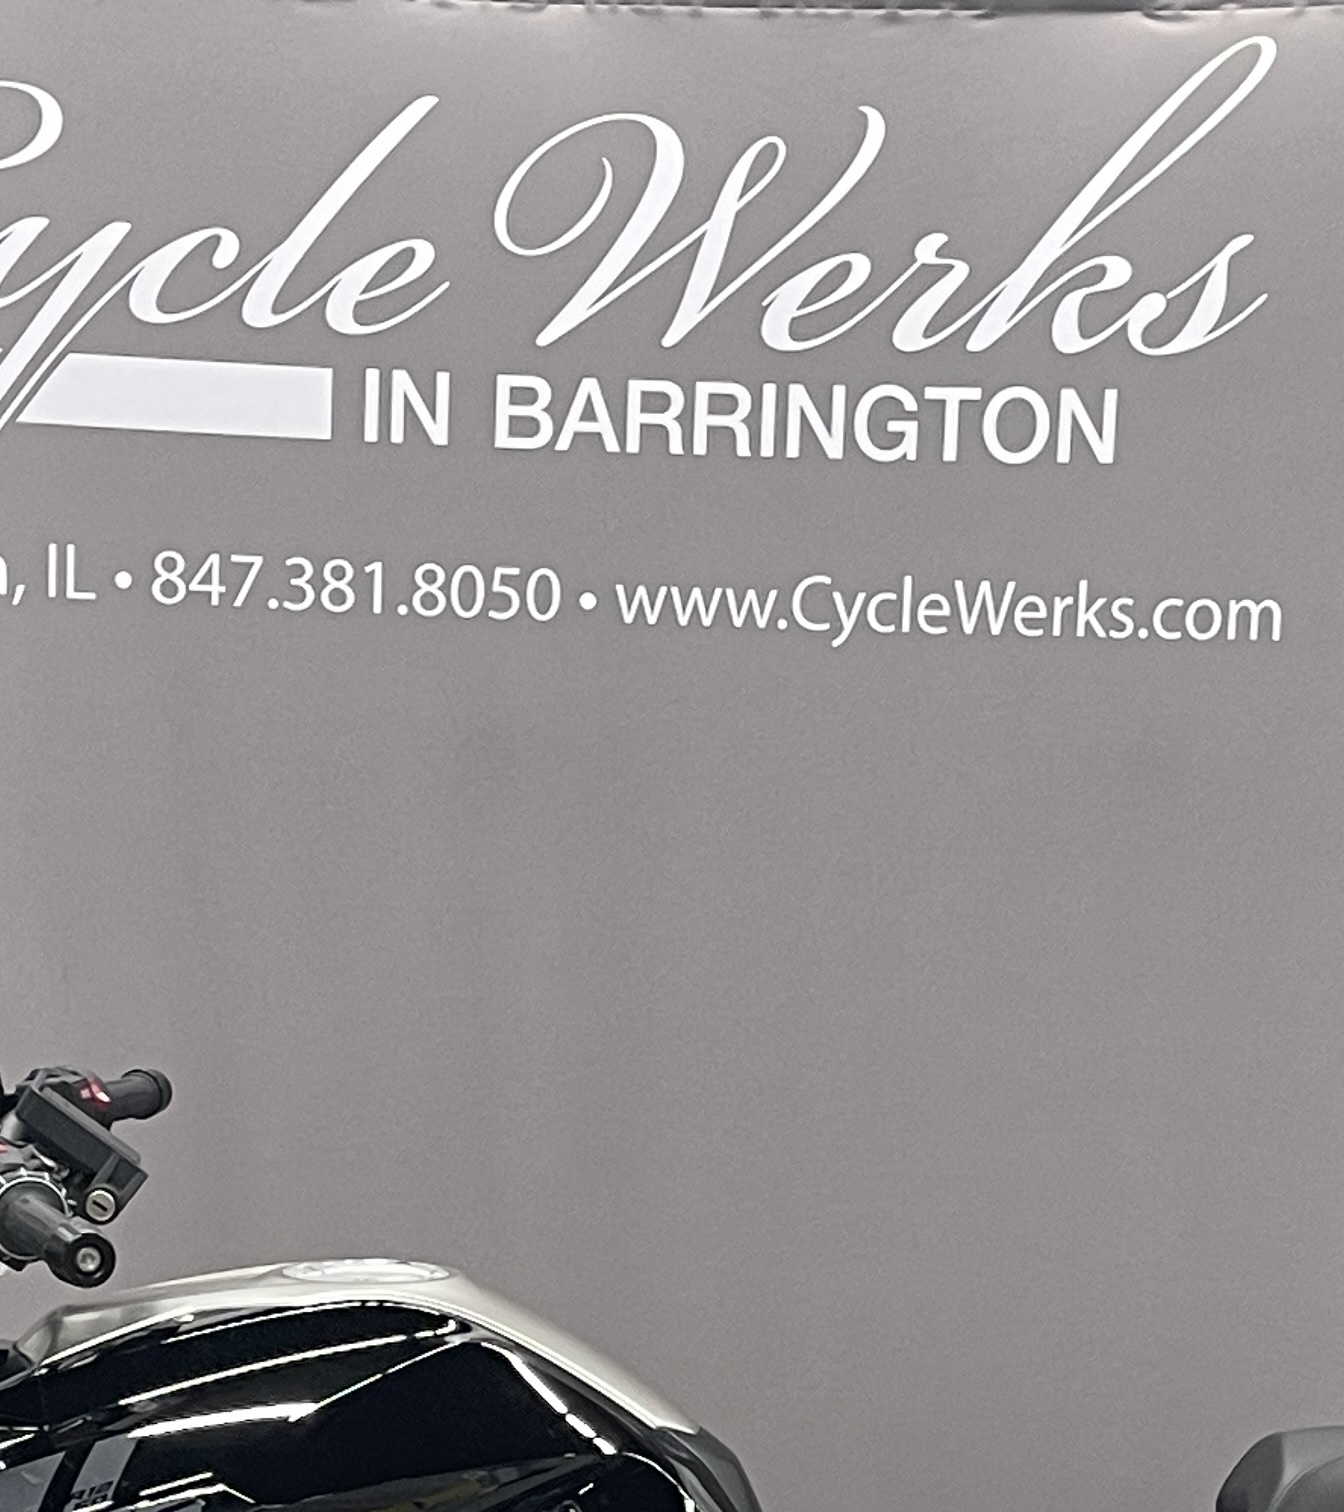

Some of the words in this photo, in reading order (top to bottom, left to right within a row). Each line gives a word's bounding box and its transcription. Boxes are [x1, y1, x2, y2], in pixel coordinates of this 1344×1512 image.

[492, 34, 1278, 357] Werks
[363, 366, 451, 447] IN
[493, 373, 1119, 465] BARRINGTON
[47, 542, 98, 601] IL
[150, 549, 562, 623] 847.381.8050
[614, 574, 1283, 649] www.CycleWerks.com
